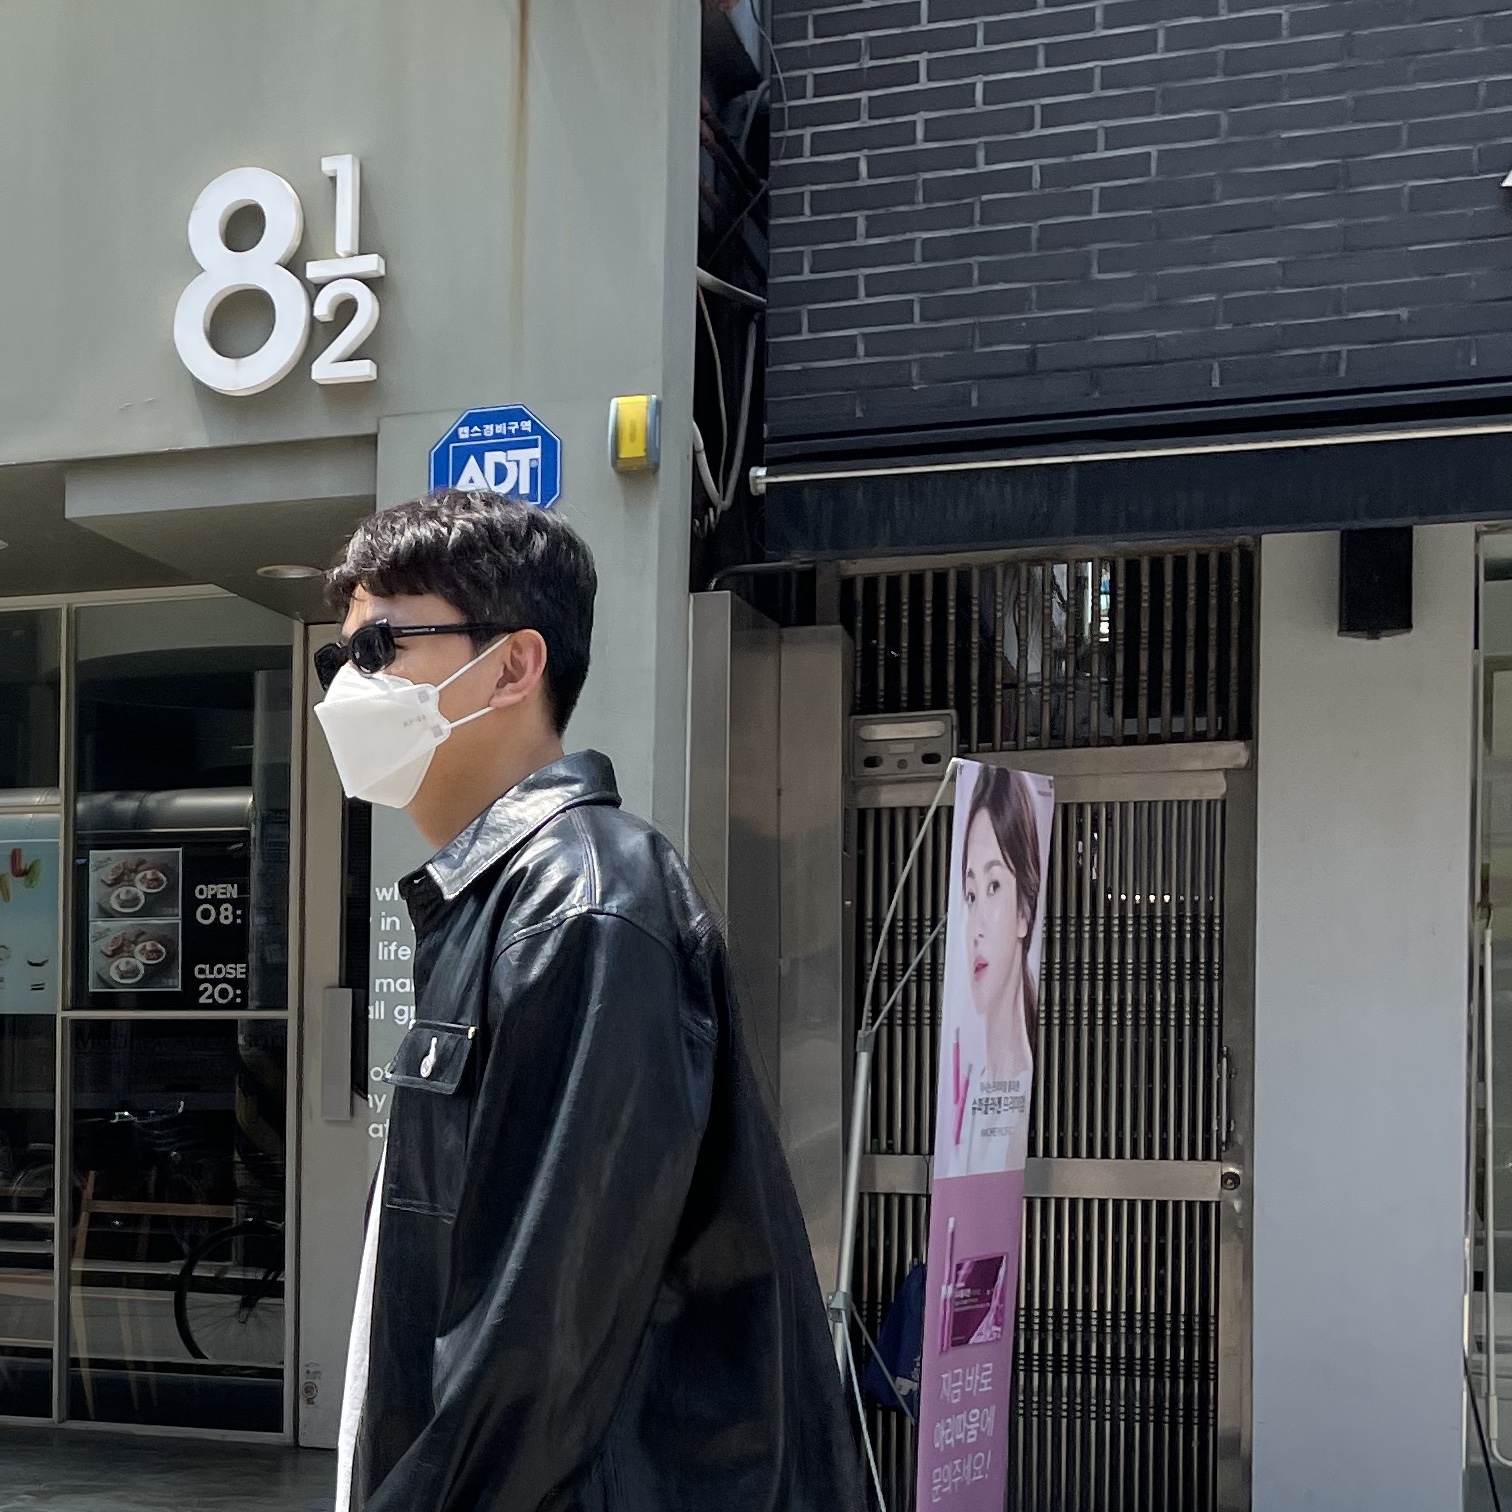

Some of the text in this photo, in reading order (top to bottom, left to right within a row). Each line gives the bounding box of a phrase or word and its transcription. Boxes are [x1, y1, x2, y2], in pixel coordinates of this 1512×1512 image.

[454, 446, 542, 495] ADT
[194, 883, 238, 899] OPEN
[381, 911, 401, 931] in
[194, 963, 247, 979] CLOSE
[939, 1362, 993, 1404] 지금 바로
